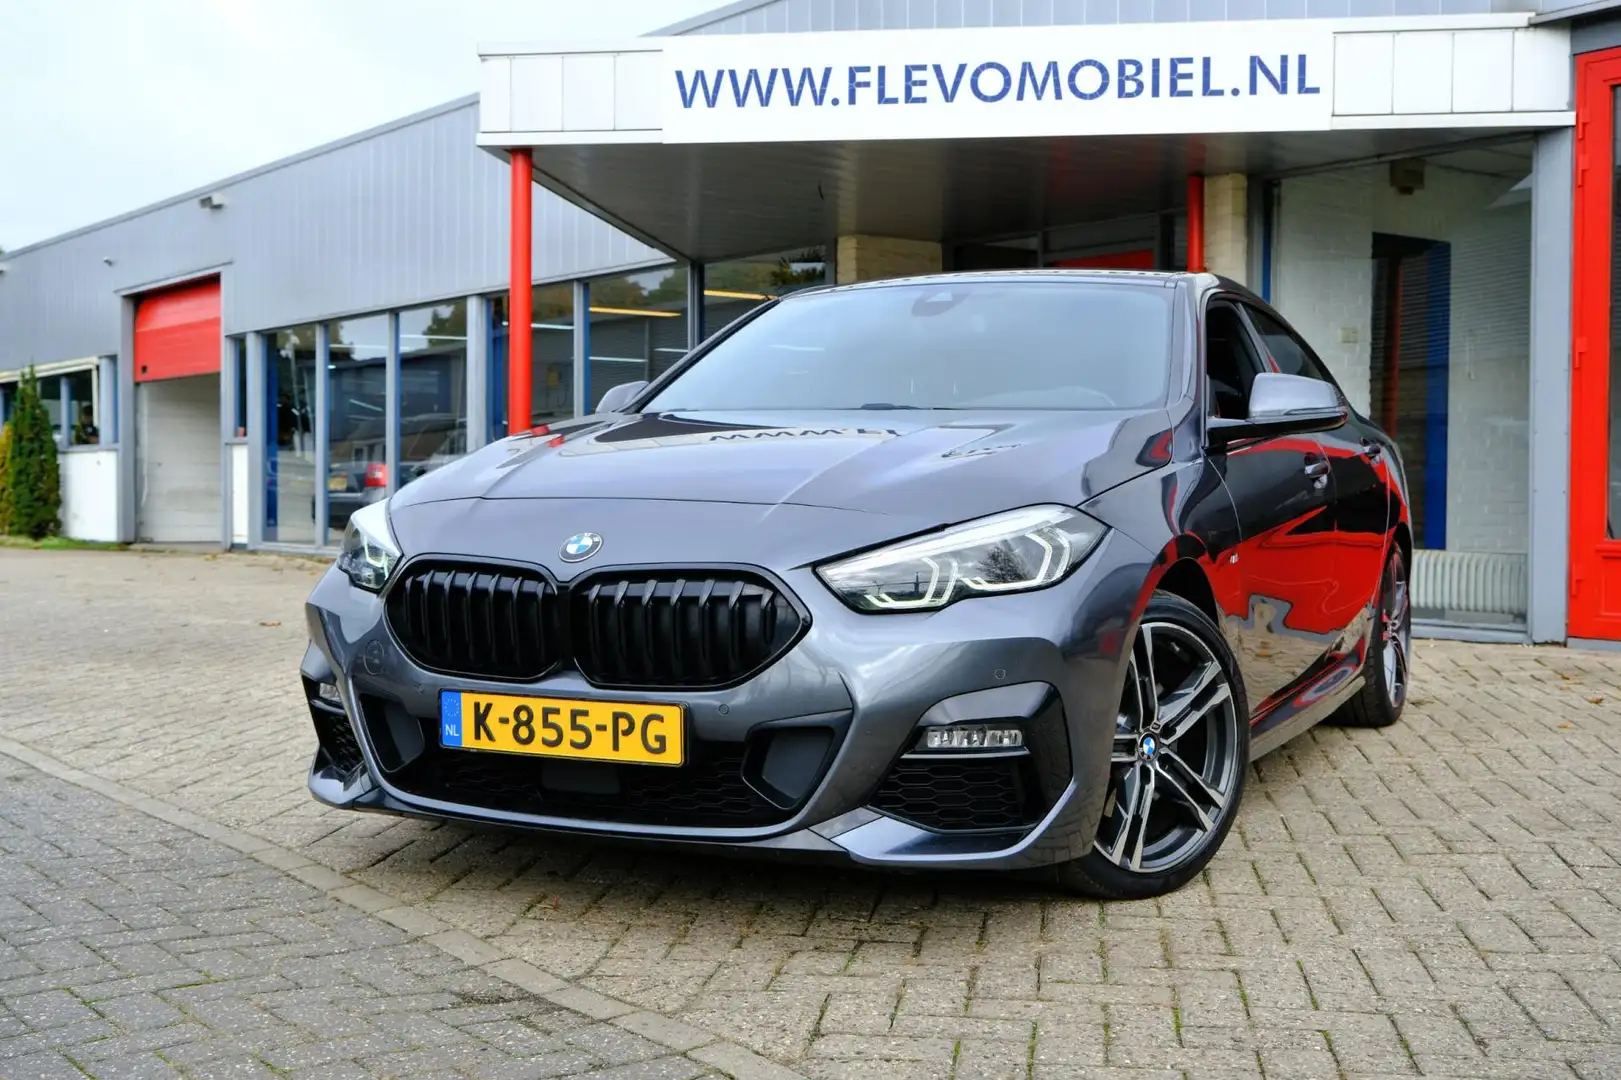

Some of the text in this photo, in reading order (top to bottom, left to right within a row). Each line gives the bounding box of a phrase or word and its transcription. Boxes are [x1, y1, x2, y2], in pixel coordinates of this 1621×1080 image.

[674, 53, 1321, 109] WWW.FLEVOMOBIEL.NL
[445, 723, 459, 737] NL
[473, 701, 667, 755] K-855-PG
